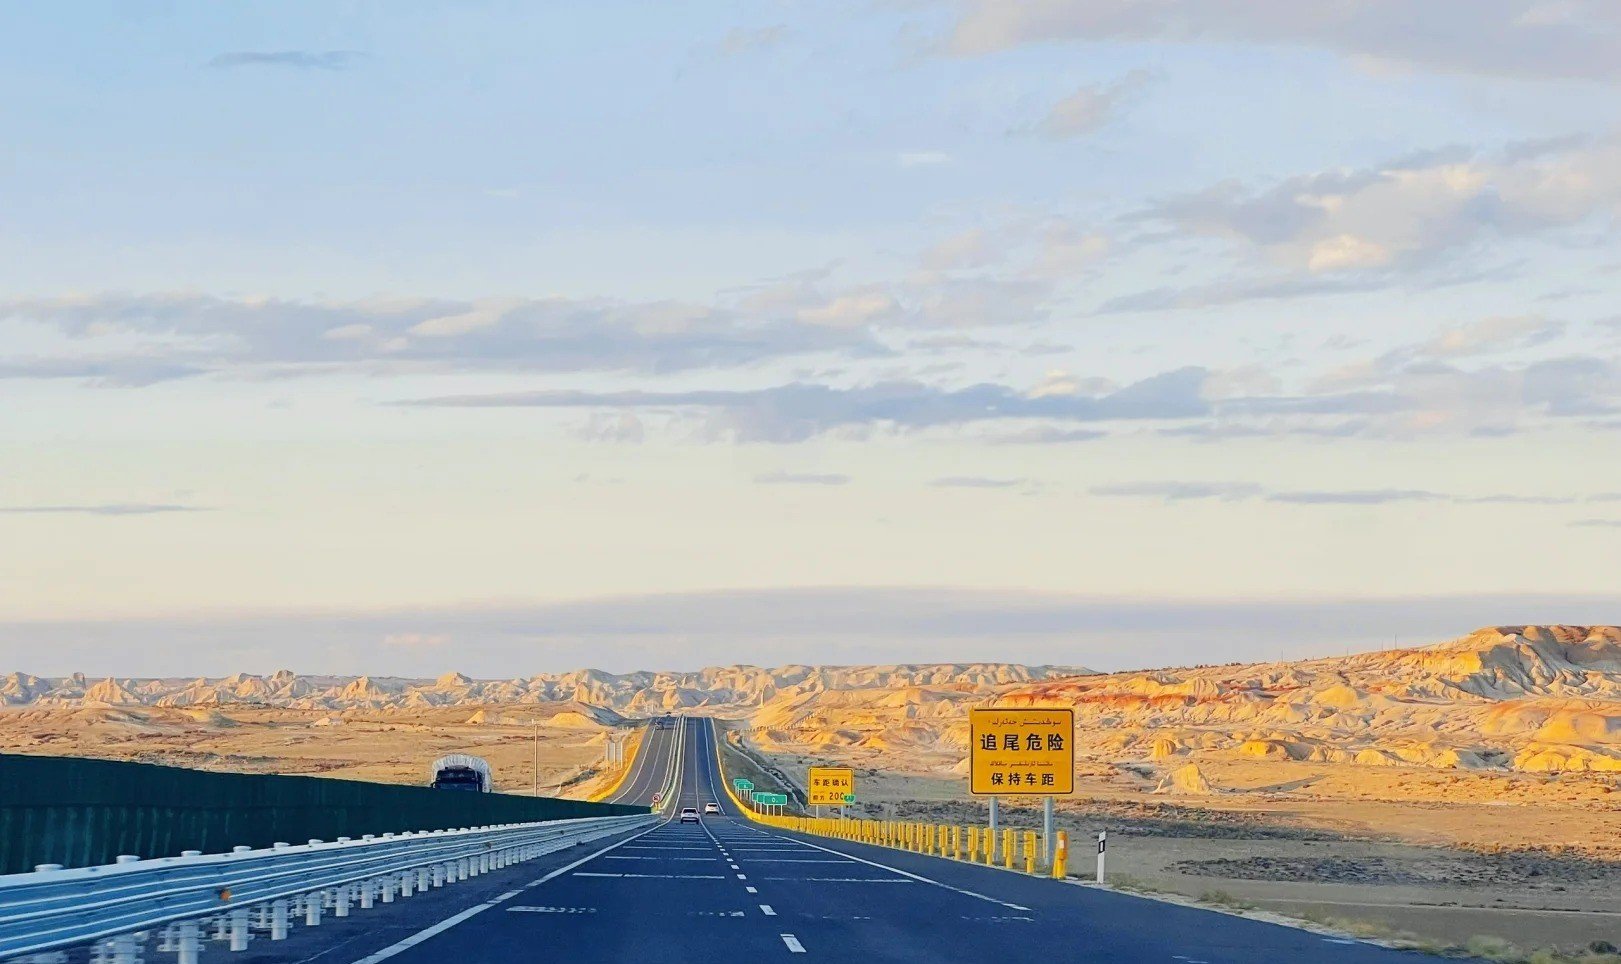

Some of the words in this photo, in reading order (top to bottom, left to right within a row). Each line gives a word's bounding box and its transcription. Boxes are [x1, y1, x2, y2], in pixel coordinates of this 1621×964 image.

[980, 733, 1064, 751] 追尾危险
[813, 778, 849, 787] 车距确认
[991, 772, 1054, 786] 保持车距
